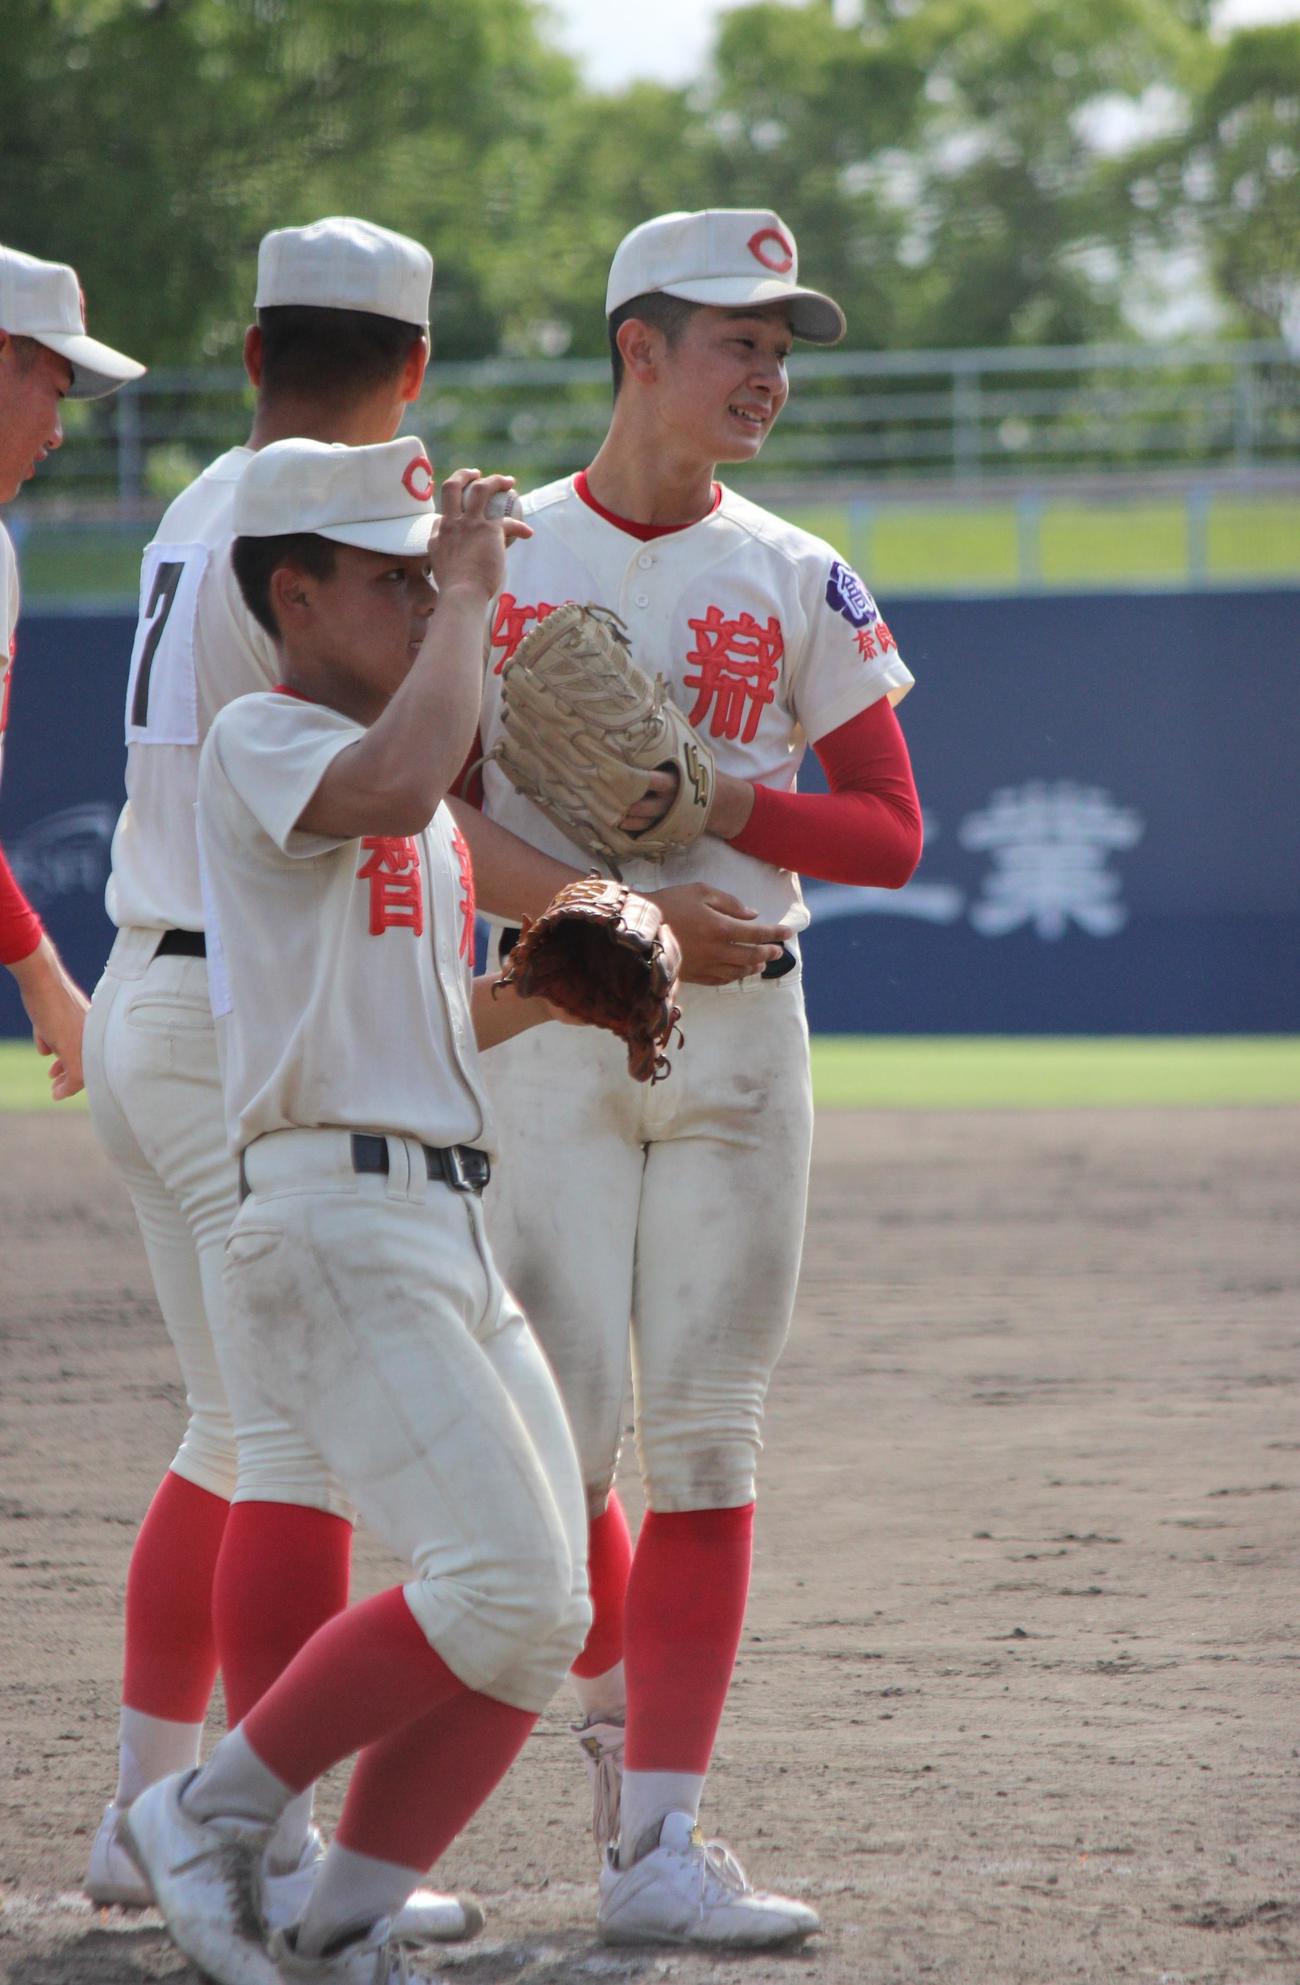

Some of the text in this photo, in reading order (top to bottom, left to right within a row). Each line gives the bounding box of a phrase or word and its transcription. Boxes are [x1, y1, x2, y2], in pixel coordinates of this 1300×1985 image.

[747, 228, 793, 274] C
[402, 456, 434, 501] C
[131, 562, 185, 727] 7
